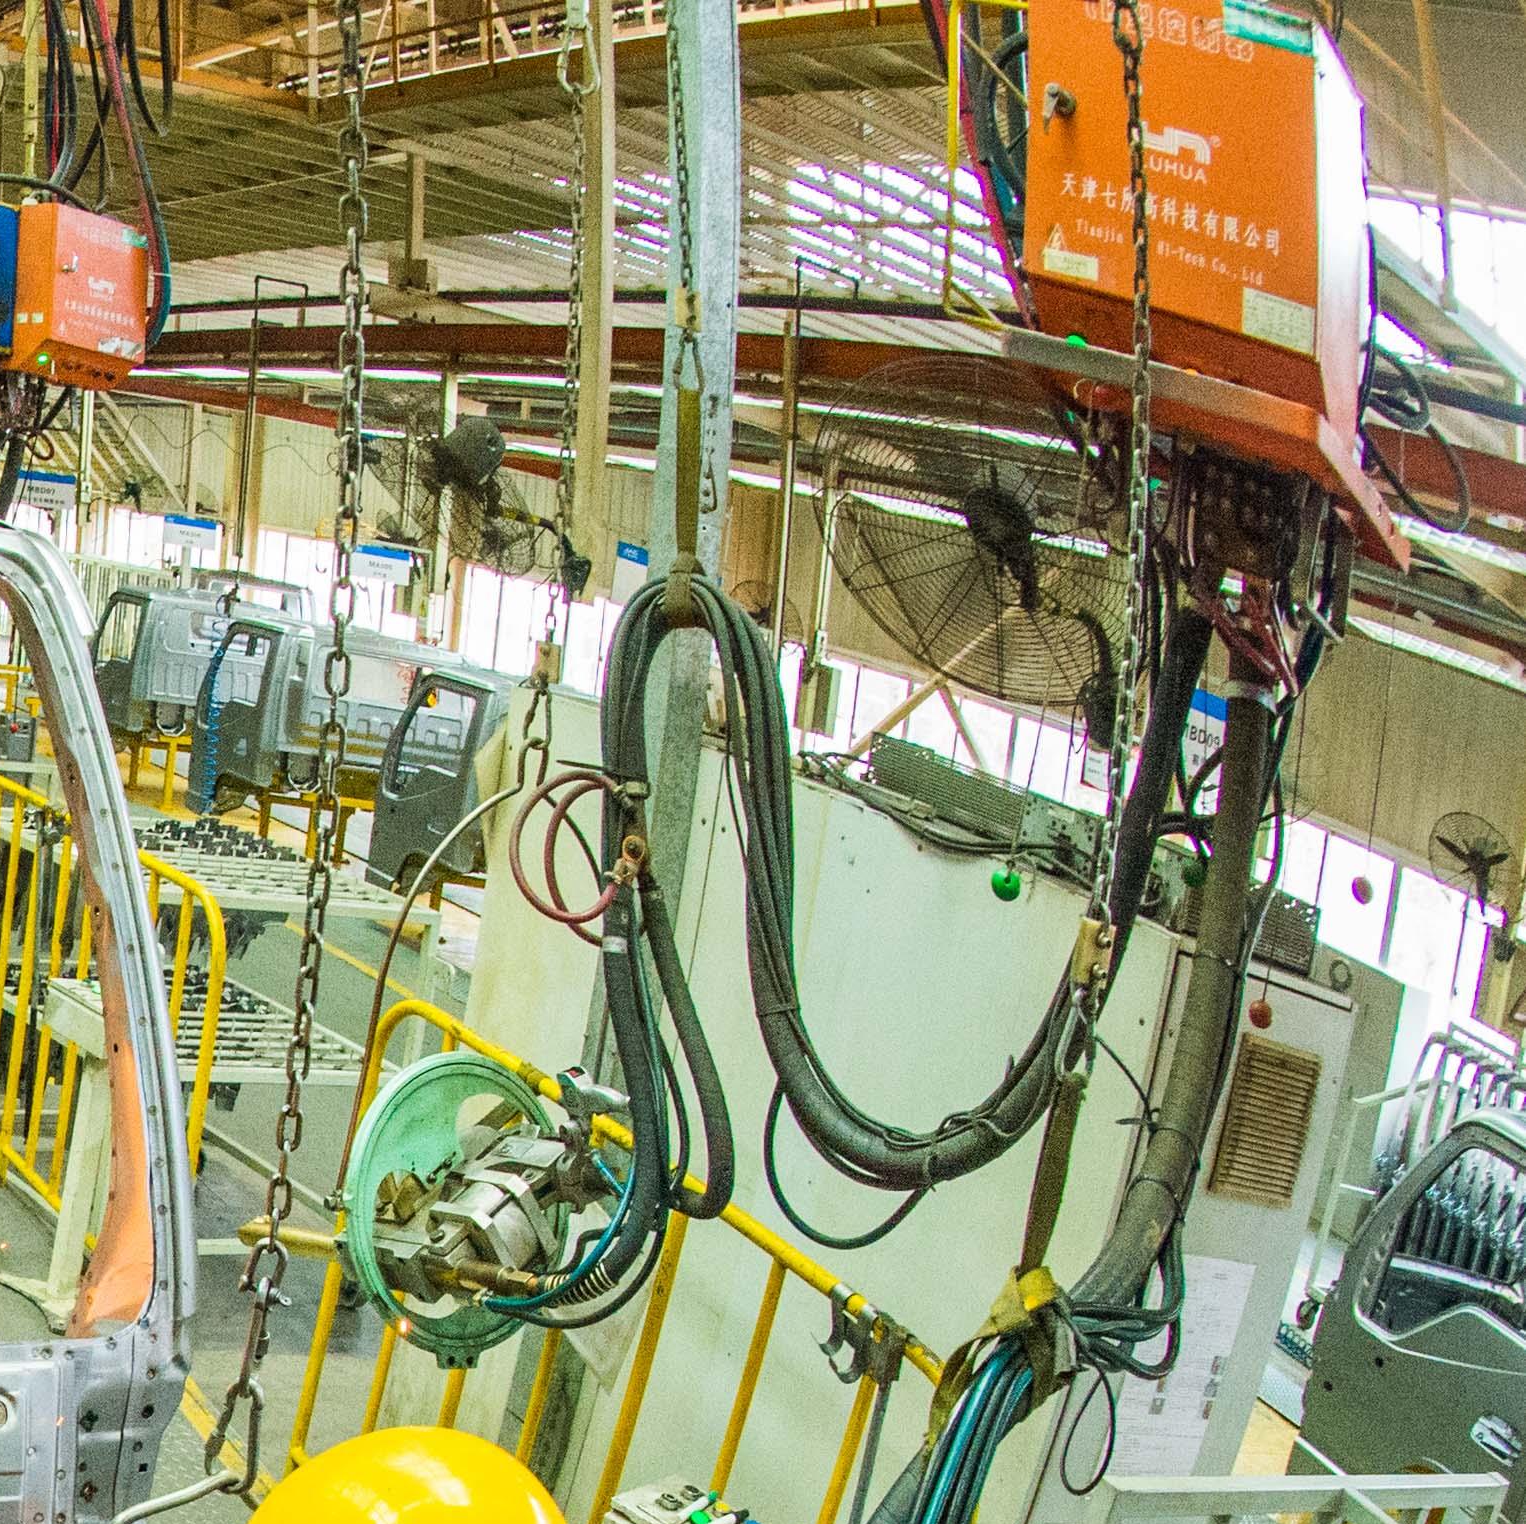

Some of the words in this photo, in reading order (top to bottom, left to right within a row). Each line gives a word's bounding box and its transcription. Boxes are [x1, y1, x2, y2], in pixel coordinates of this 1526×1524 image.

[1144, 157, 1207, 185] UHUA
[1060, 172, 1280, 257] 天津七所高科技有限公司
[1075, 218, 1124, 244] Tianjin
[1157, 240, 1206, 268] Hi-Tech
[1184, 724, 1220, 748] BD09
